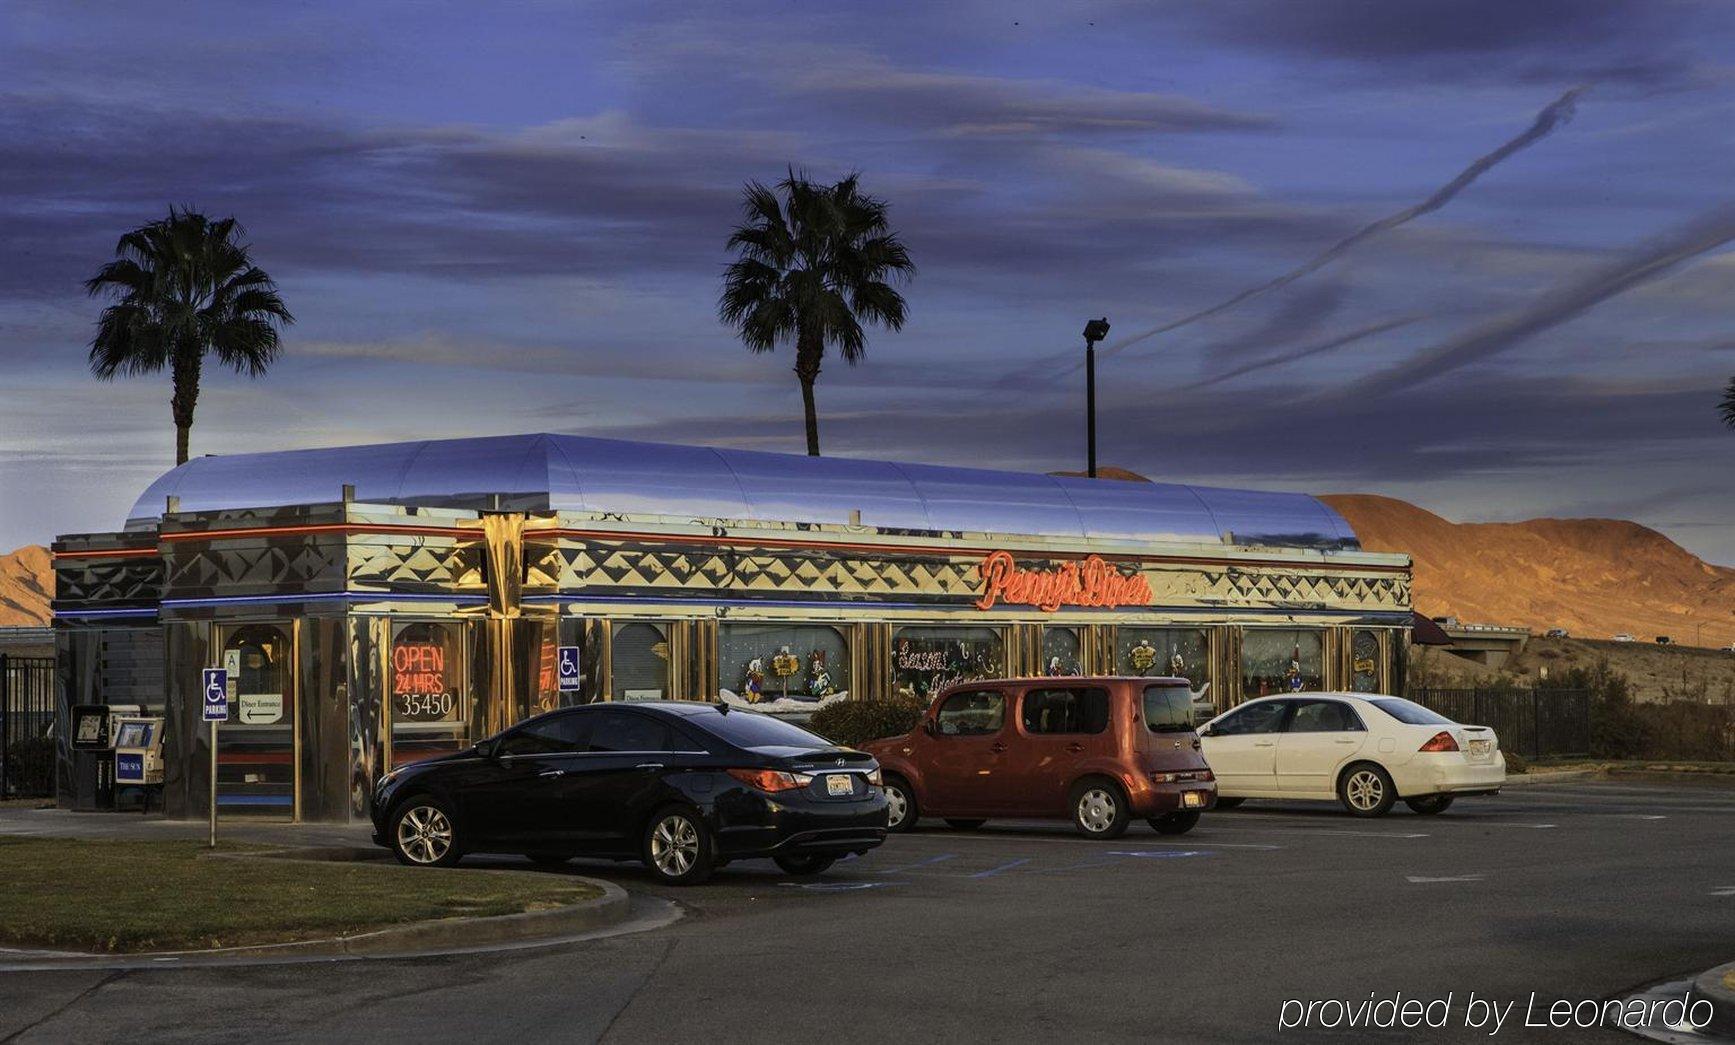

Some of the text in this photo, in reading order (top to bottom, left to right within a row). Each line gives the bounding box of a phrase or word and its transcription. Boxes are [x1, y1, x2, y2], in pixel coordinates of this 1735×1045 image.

[976, 551, 1154, 612] Penny's Diner
[228, 654, 236, 666] A
[394, 646, 444, 672] OPEN
[395, 673, 444, 694] 24 HRS
[560, 677, 578, 685] PARKING
[205, 705, 226, 715] PARKING
[402, 693, 452, 715] 35450
